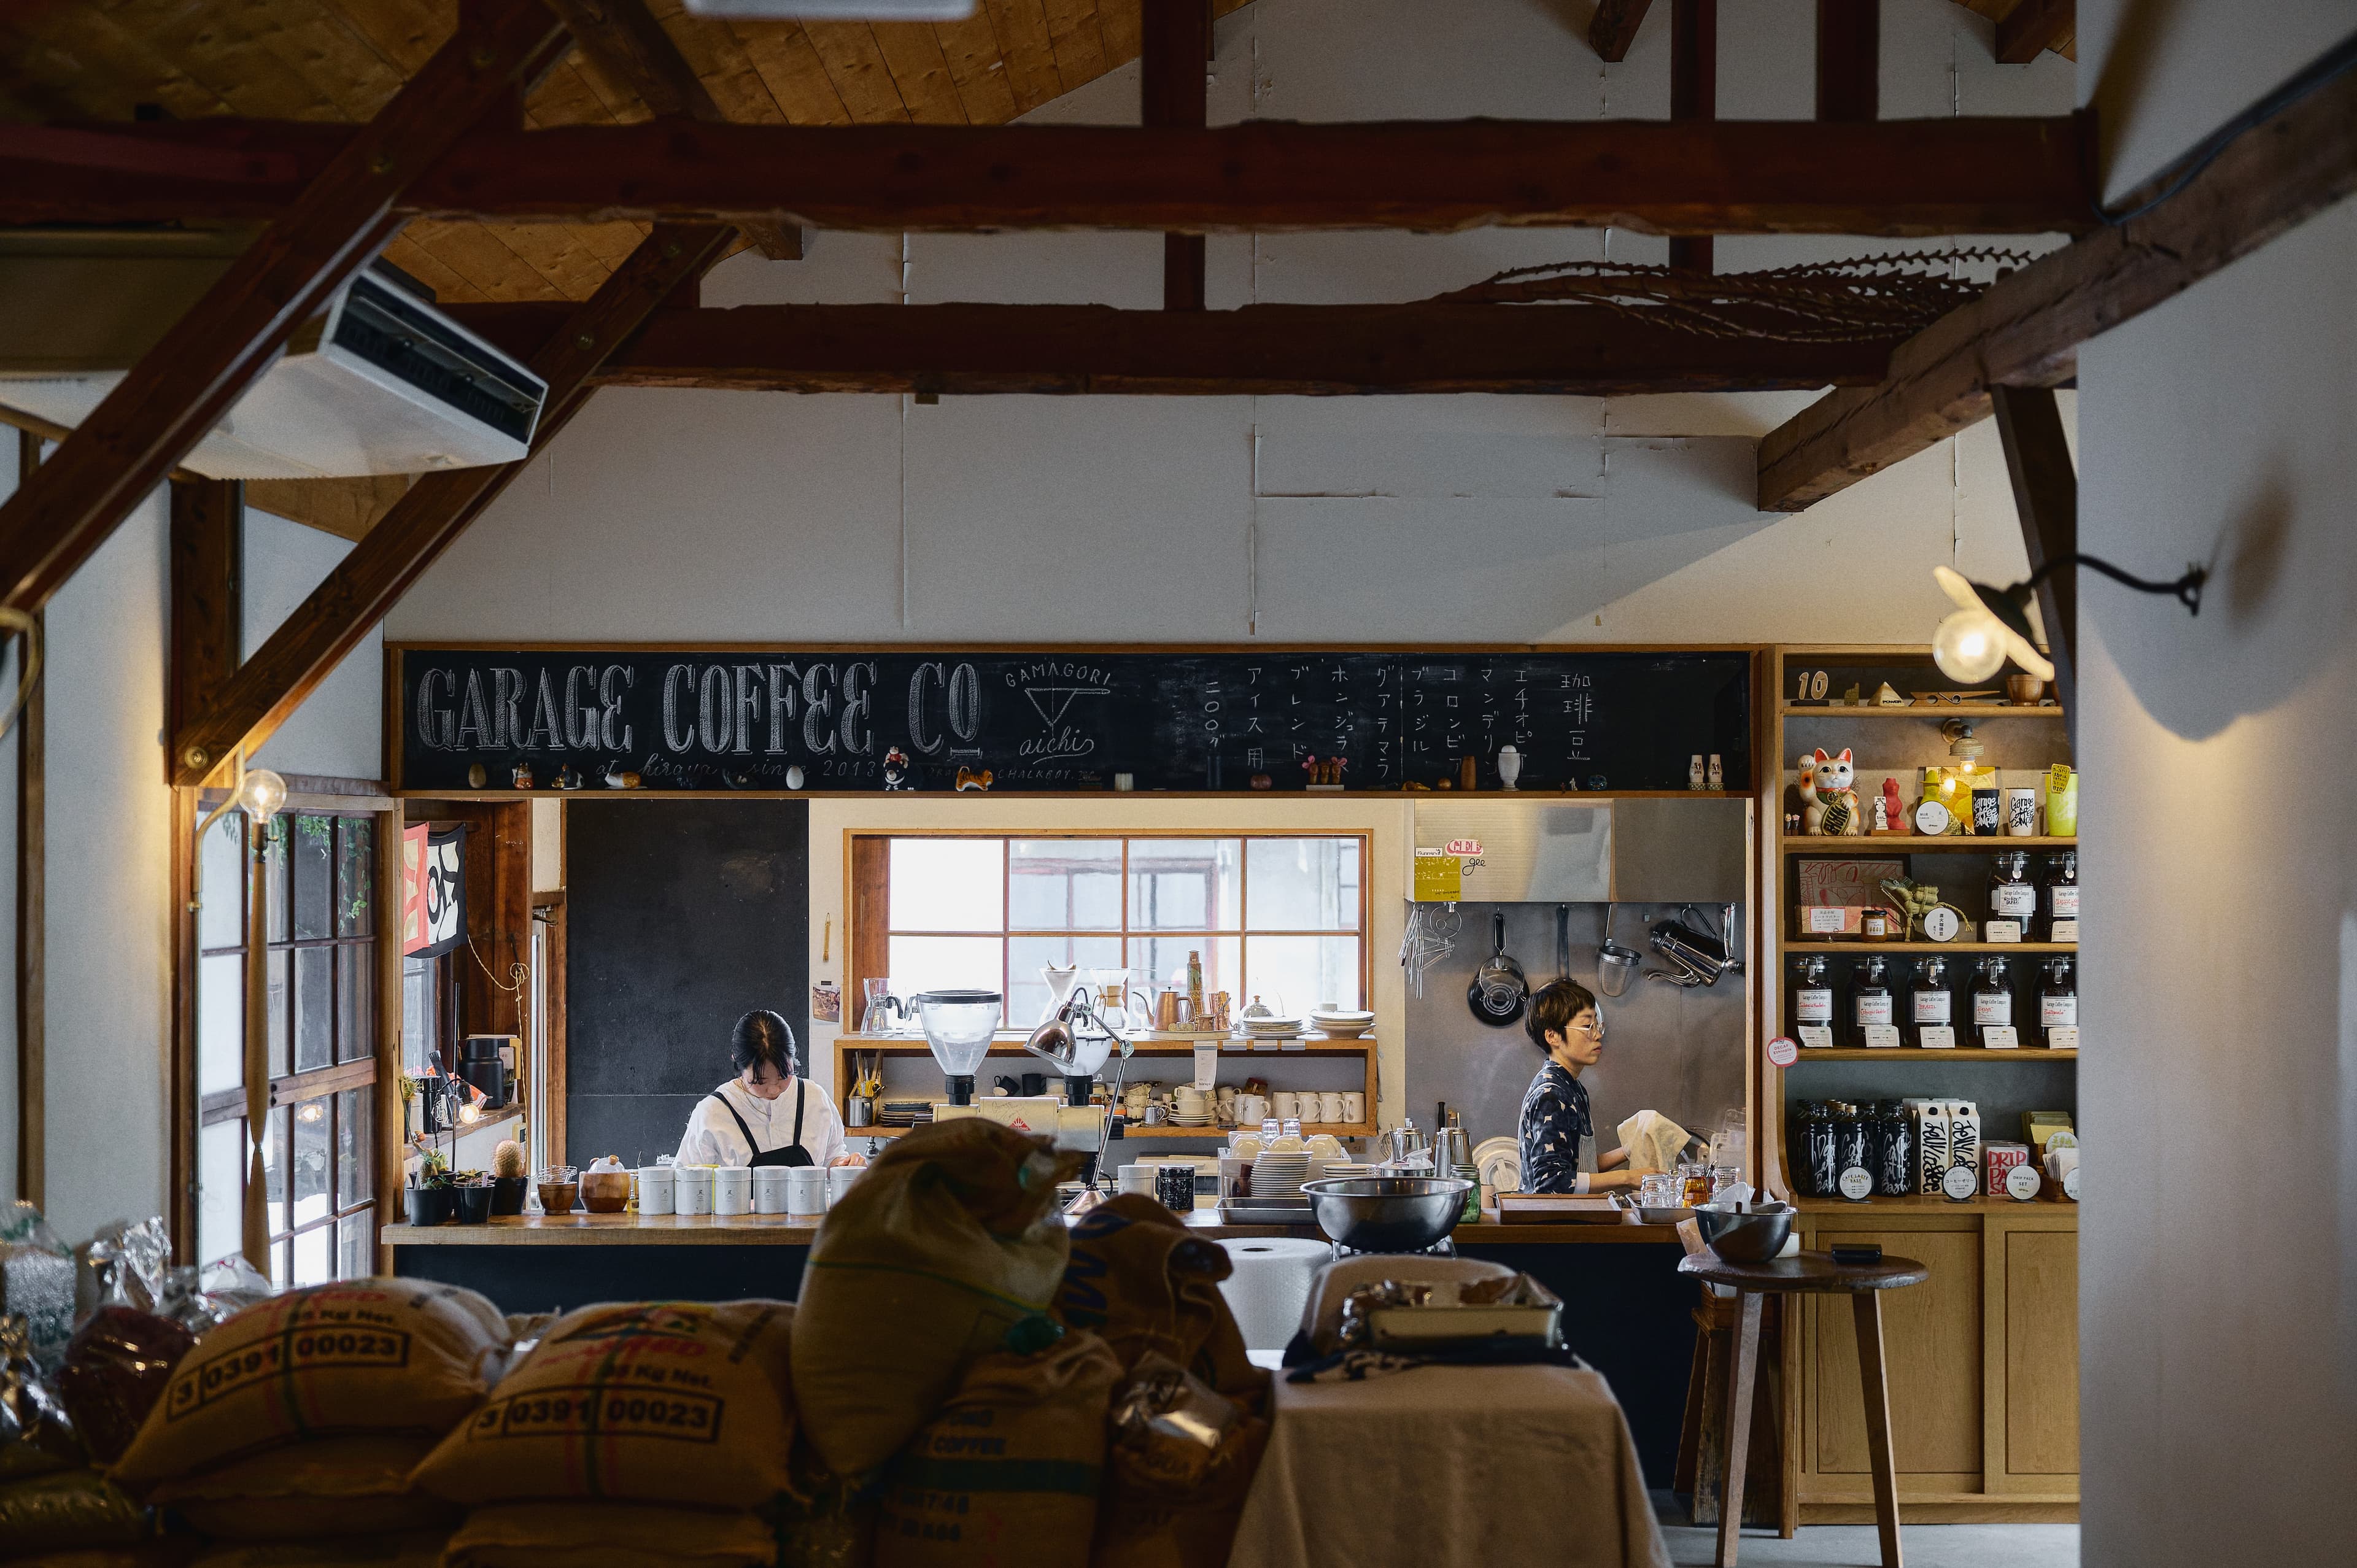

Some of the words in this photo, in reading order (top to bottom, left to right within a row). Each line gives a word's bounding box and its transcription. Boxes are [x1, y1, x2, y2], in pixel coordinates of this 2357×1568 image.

[417, 665, 635, 752] GARAGE
[663, 663, 878, 755] COFFEE
[908, 662, 983, 759] CO
[1005, 662, 1110, 688] GAMAGORI
[1291, 665, 1310, 760] ブレンド
[1412, 666, 1429, 752] ブラジル
[1799, 671, 1828, 700] 10
[1247, 668, 1264, 770] アイス用
[1377, 665, 1394, 778] グアテマラ
[1444, 669, 1465, 774] コロンビア
[1481, 670, 1499, 774] マンデリン
[1561, 673, 1593, 760] 珈琲豆
[823, 760, 876, 777] 2013
[1462, 858, 1486, 876] gee
[1987, 1150, 2027, 1168] DRIP
[1989, 1167, 2008, 1184] PA
[177, 1383, 193, 1406] 3
[205, 1348, 279, 1389] 0391
[297, 1335, 396, 1357] 00023
[509, 1399, 588, 1423] 0391
[607, 1398, 707, 1427] 00023
